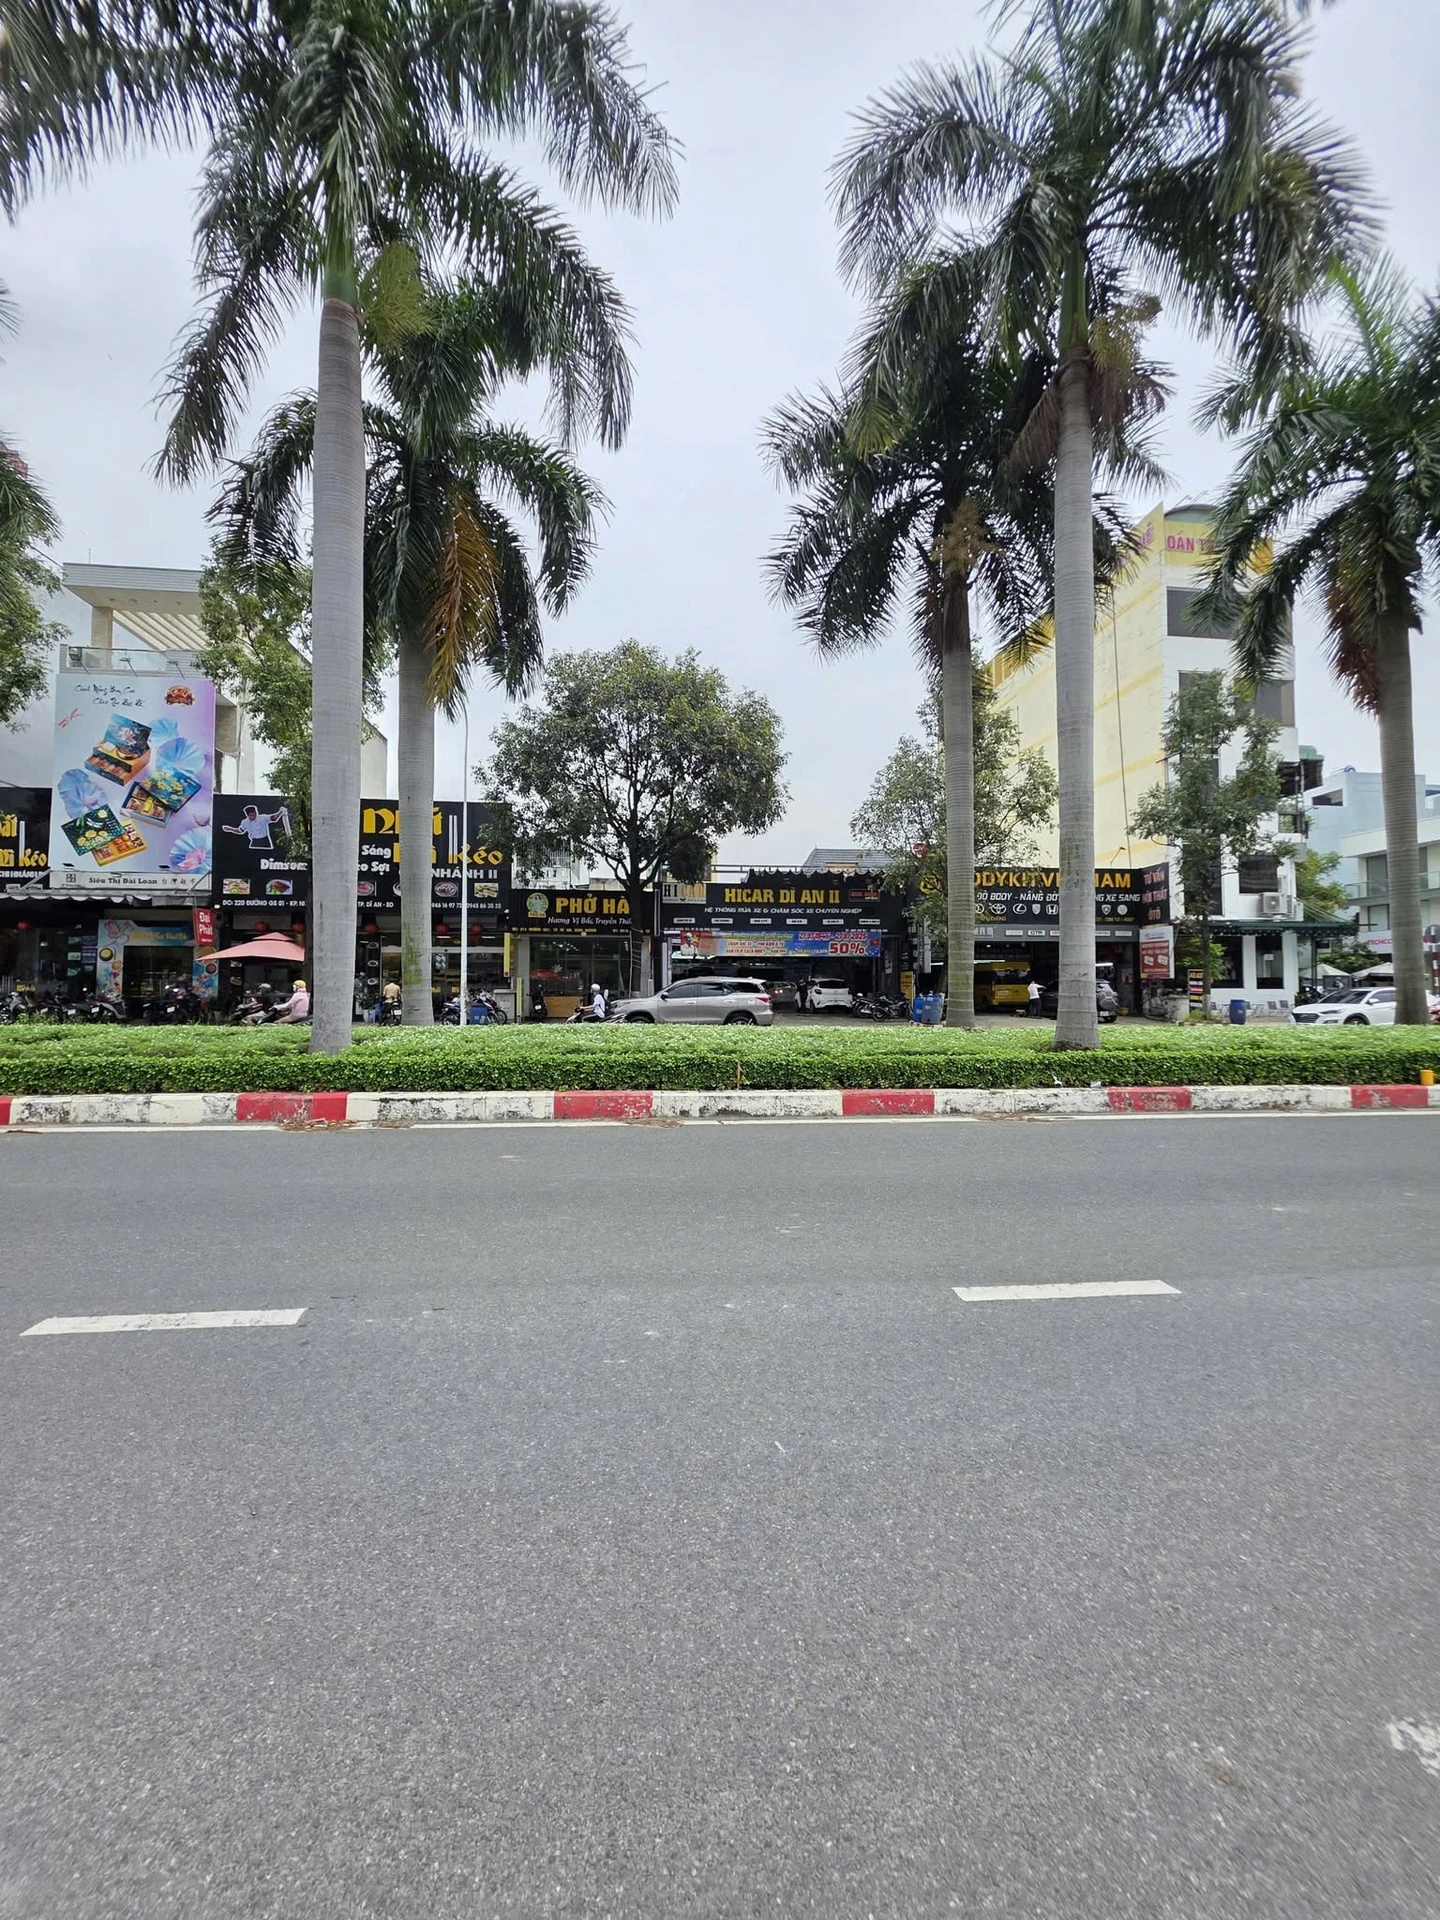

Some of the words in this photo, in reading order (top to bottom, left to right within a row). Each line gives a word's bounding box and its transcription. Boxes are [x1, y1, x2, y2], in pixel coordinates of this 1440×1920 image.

[361, 843, 391, 858] Sáng
[138, 877, 158, 885] Loan
[724, 888, 774, 903] HICAR
[800, 889, 824, 904] AN
[829, 889, 840, 904] II
[989, 892, 1013, 901] BODY
[1105, 893, 1118, 902] XE
[1118, 893, 1141, 902] SANG
[555, 893, 597, 914] PHỞ
[603, 895, 630, 914] HÀ
[829, 941, 866, 955] 50%
